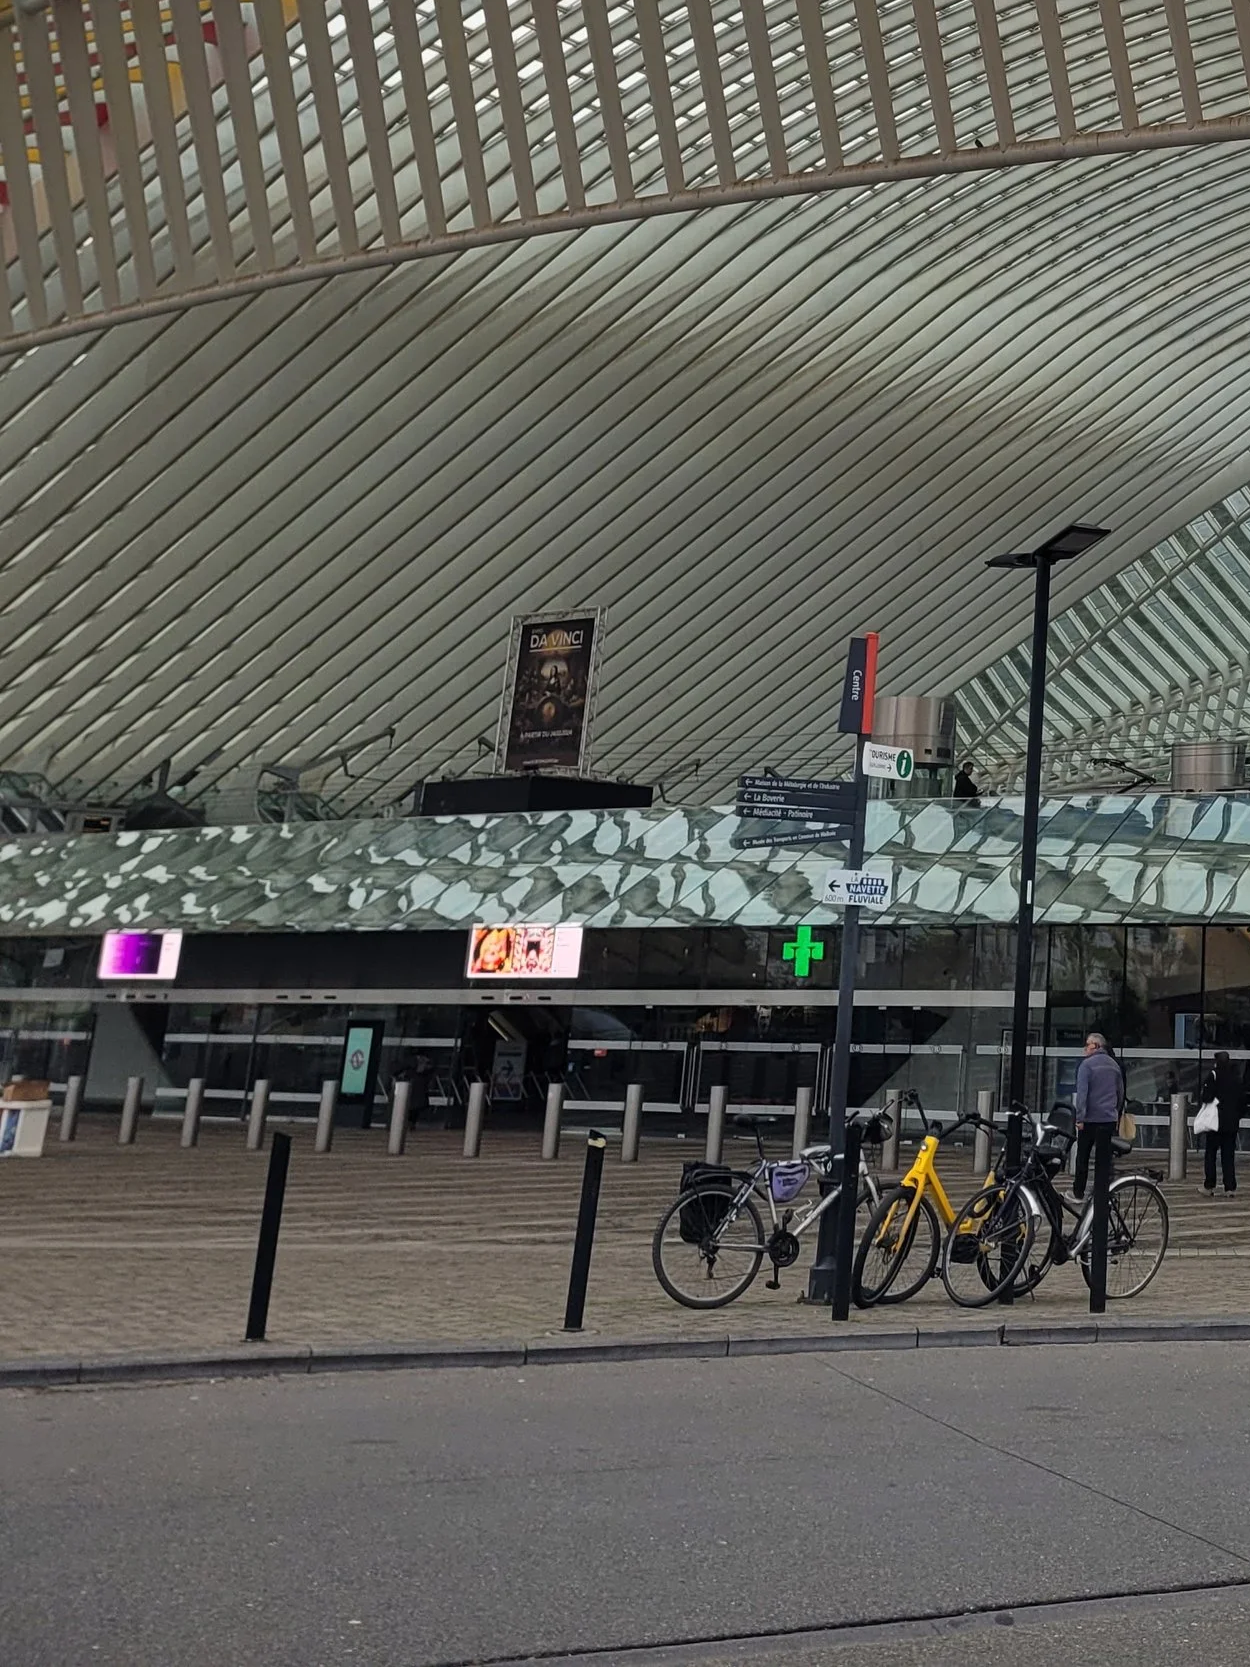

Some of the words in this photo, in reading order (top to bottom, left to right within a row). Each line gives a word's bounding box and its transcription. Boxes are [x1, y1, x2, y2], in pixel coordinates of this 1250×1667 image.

[530, 633, 548, 648] DA
[551, 630, 584, 646] VINCI
[851, 669, 862, 701] Centre
[753, 793, 761, 802] La
[762, 793, 785, 803] Boverie
[752, 807, 782, 817] Médiacité
[788, 809, 814, 819] Patinoire
[849, 884, 885, 895] NAVETTE
[825, 894, 836, 903] 600
[848, 895, 884, 905] FLUVIALE
